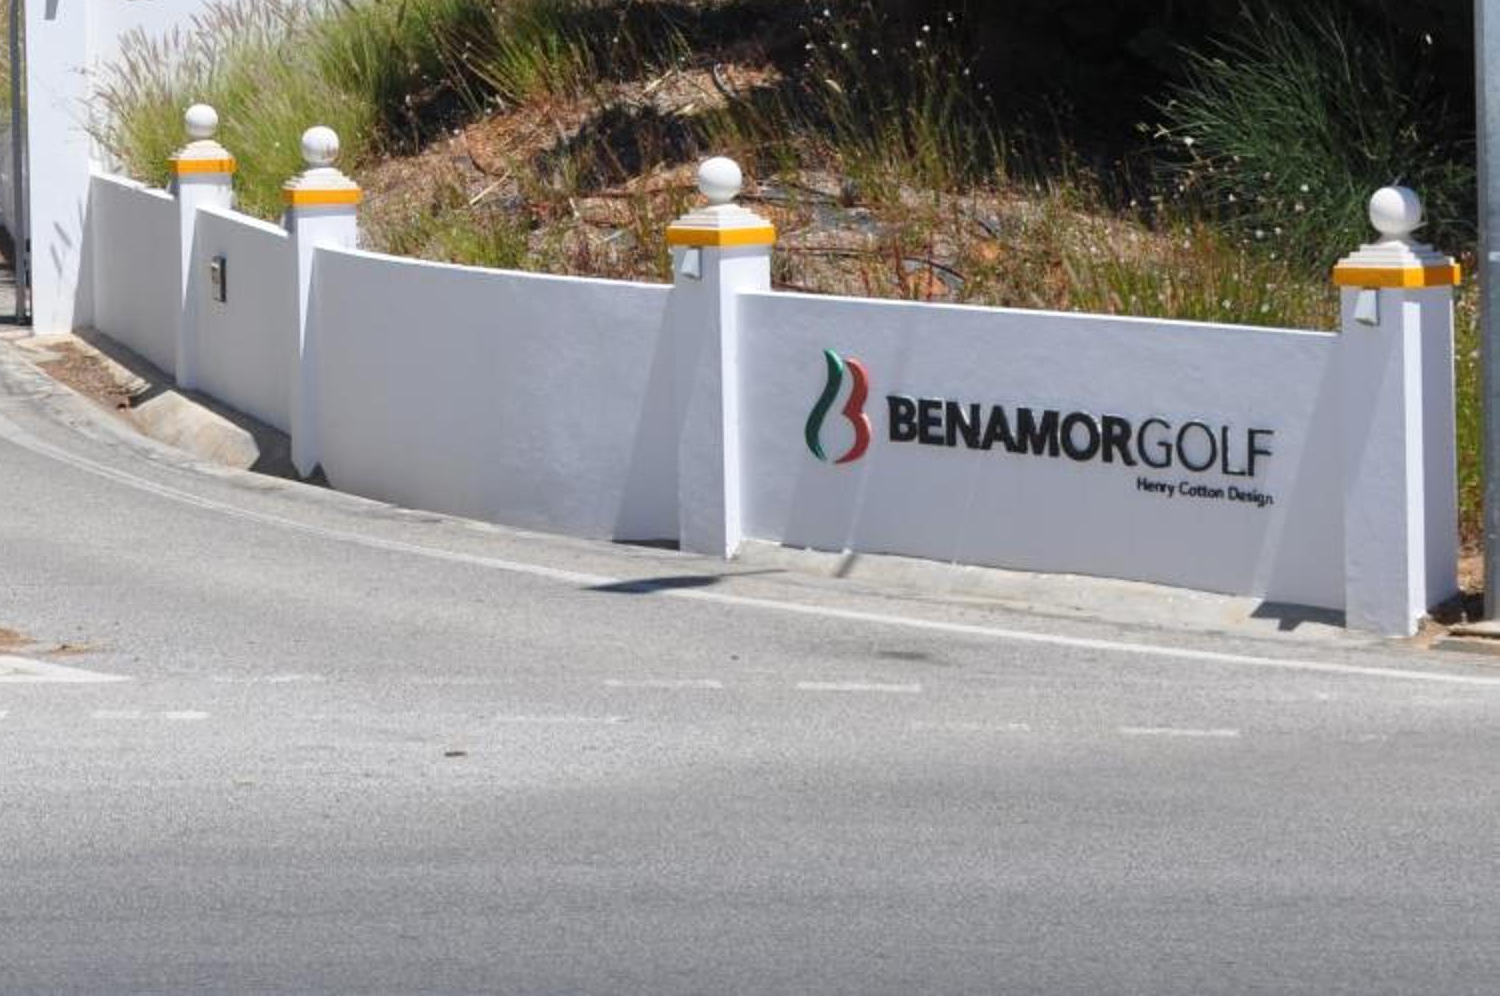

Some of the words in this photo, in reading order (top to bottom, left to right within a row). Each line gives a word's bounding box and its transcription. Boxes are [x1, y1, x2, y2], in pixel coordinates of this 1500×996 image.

[1137, 476, 1176, 498] Henry
[1178, 481, 1225, 500] Cotton
[1227, 485, 1275, 508] Design
